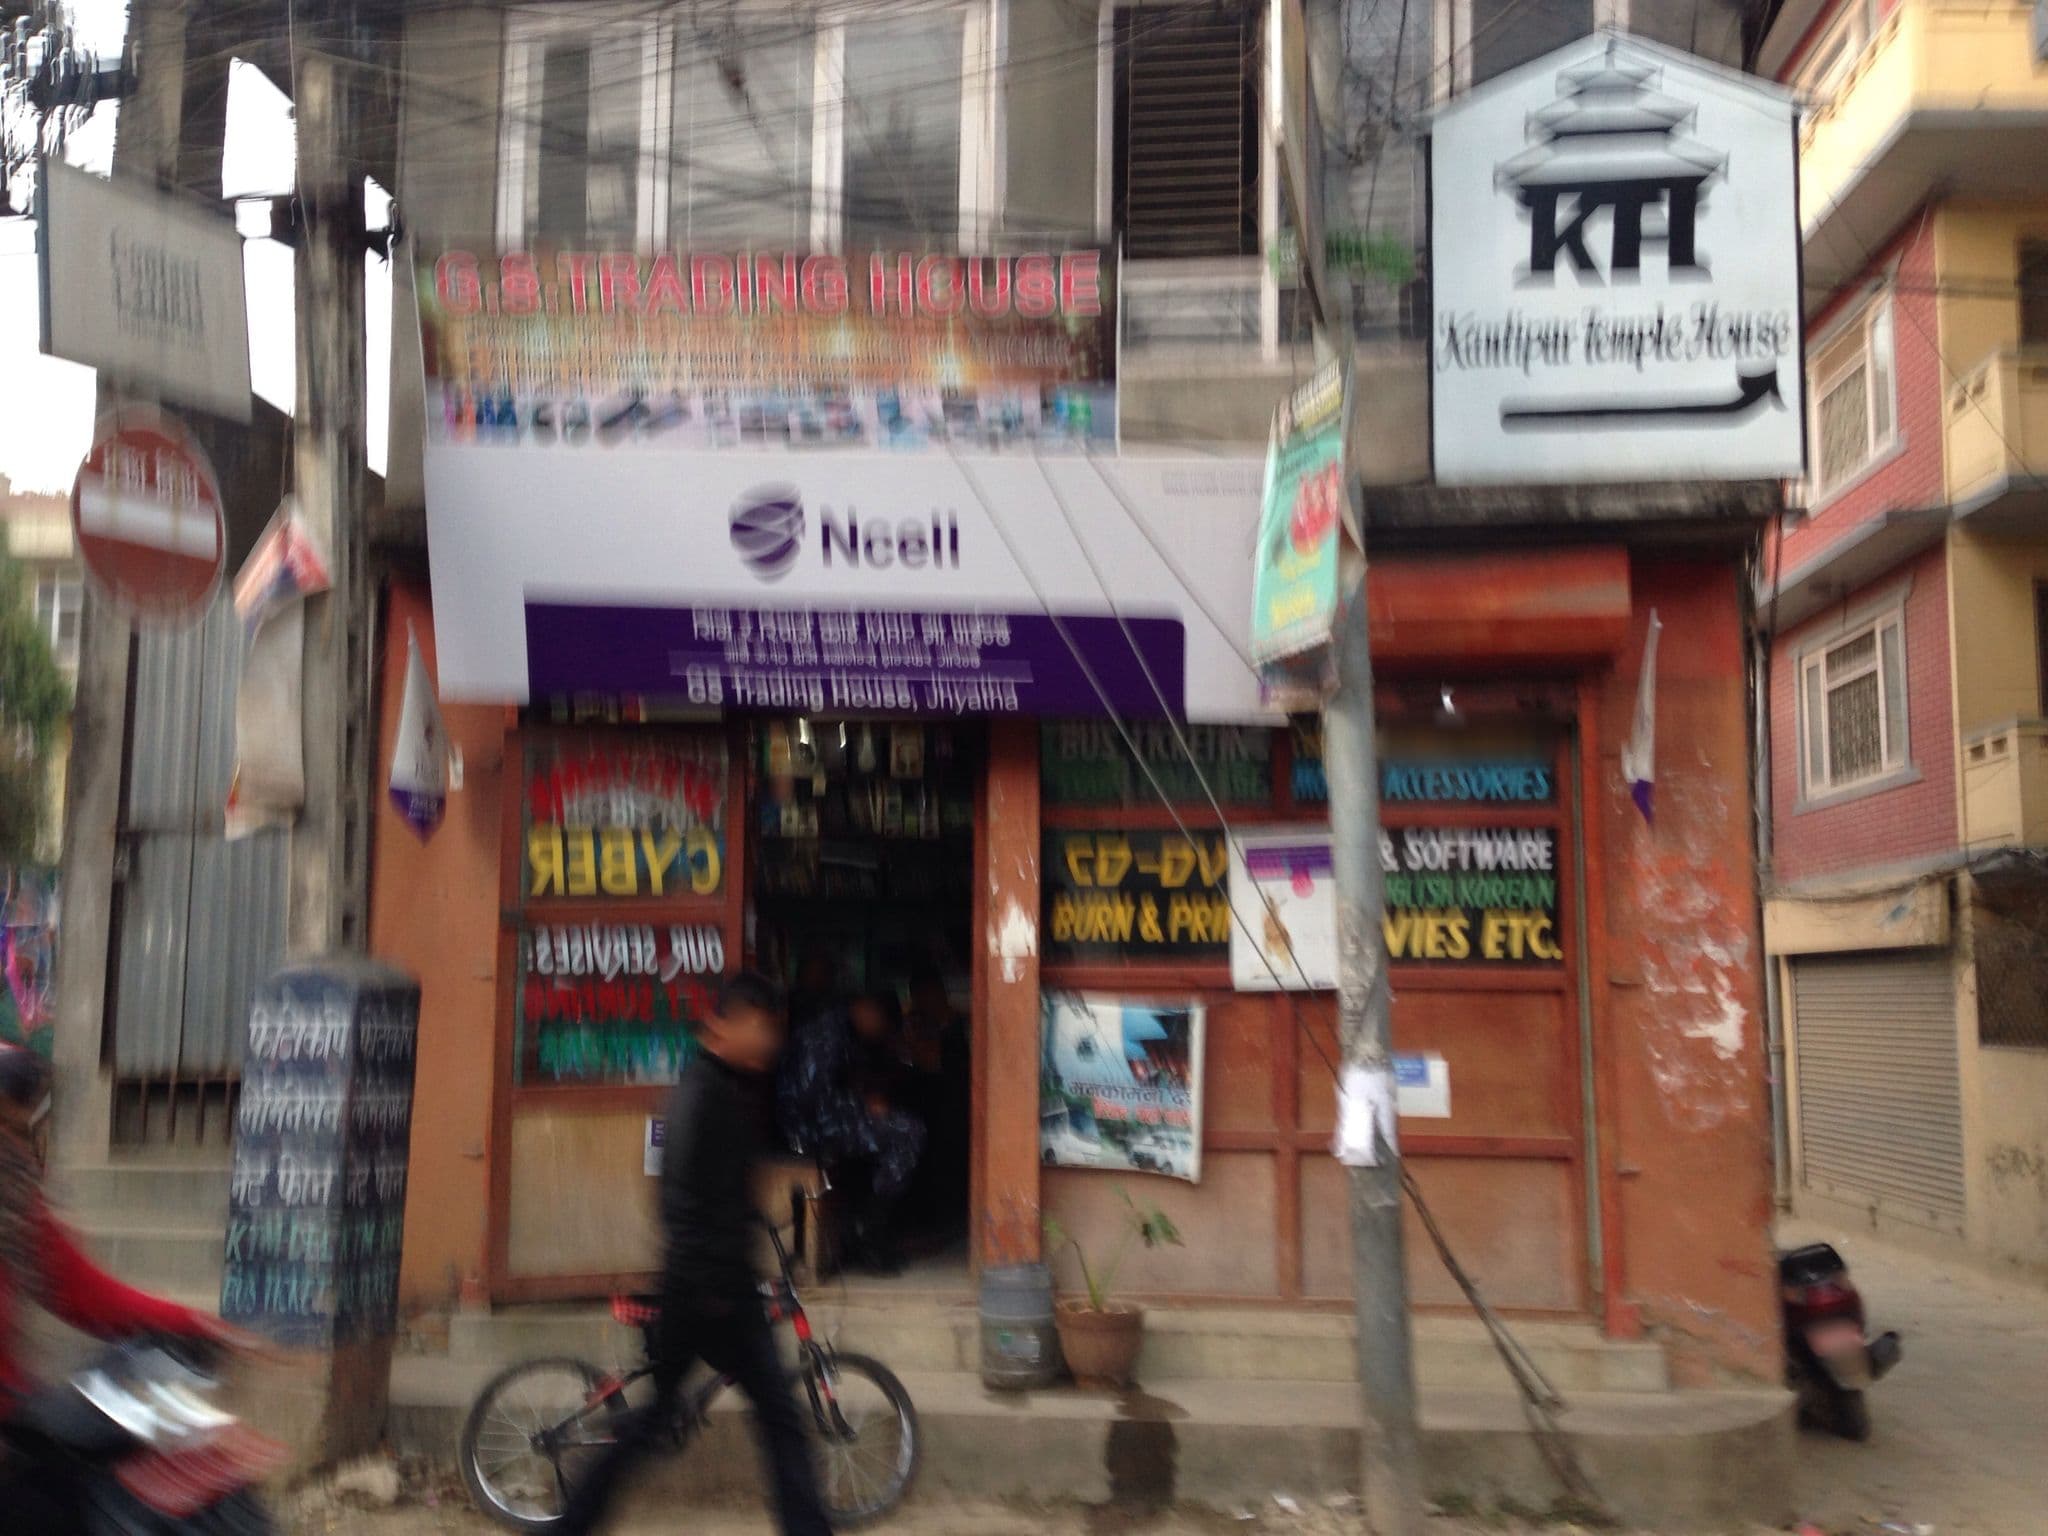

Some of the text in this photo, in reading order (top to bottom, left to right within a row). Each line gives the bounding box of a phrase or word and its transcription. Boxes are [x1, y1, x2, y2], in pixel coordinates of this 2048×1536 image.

[558, 251, 849, 317] TRADING
[867, 250, 1102, 317] HOUSE
[1582, 302, 1684, 372] Temple
[1686, 299, 1790, 362] House
[819, 503, 961, 571] Ncell
[1065, 833, 1229, 888] CD-DV
[1404, 828, 1553, 871] SOFTWARE
[1053, 889, 1135, 943] BURN
[1138, 890, 1164, 943] &
[1381, 907, 1563, 960] VIES ETC.
